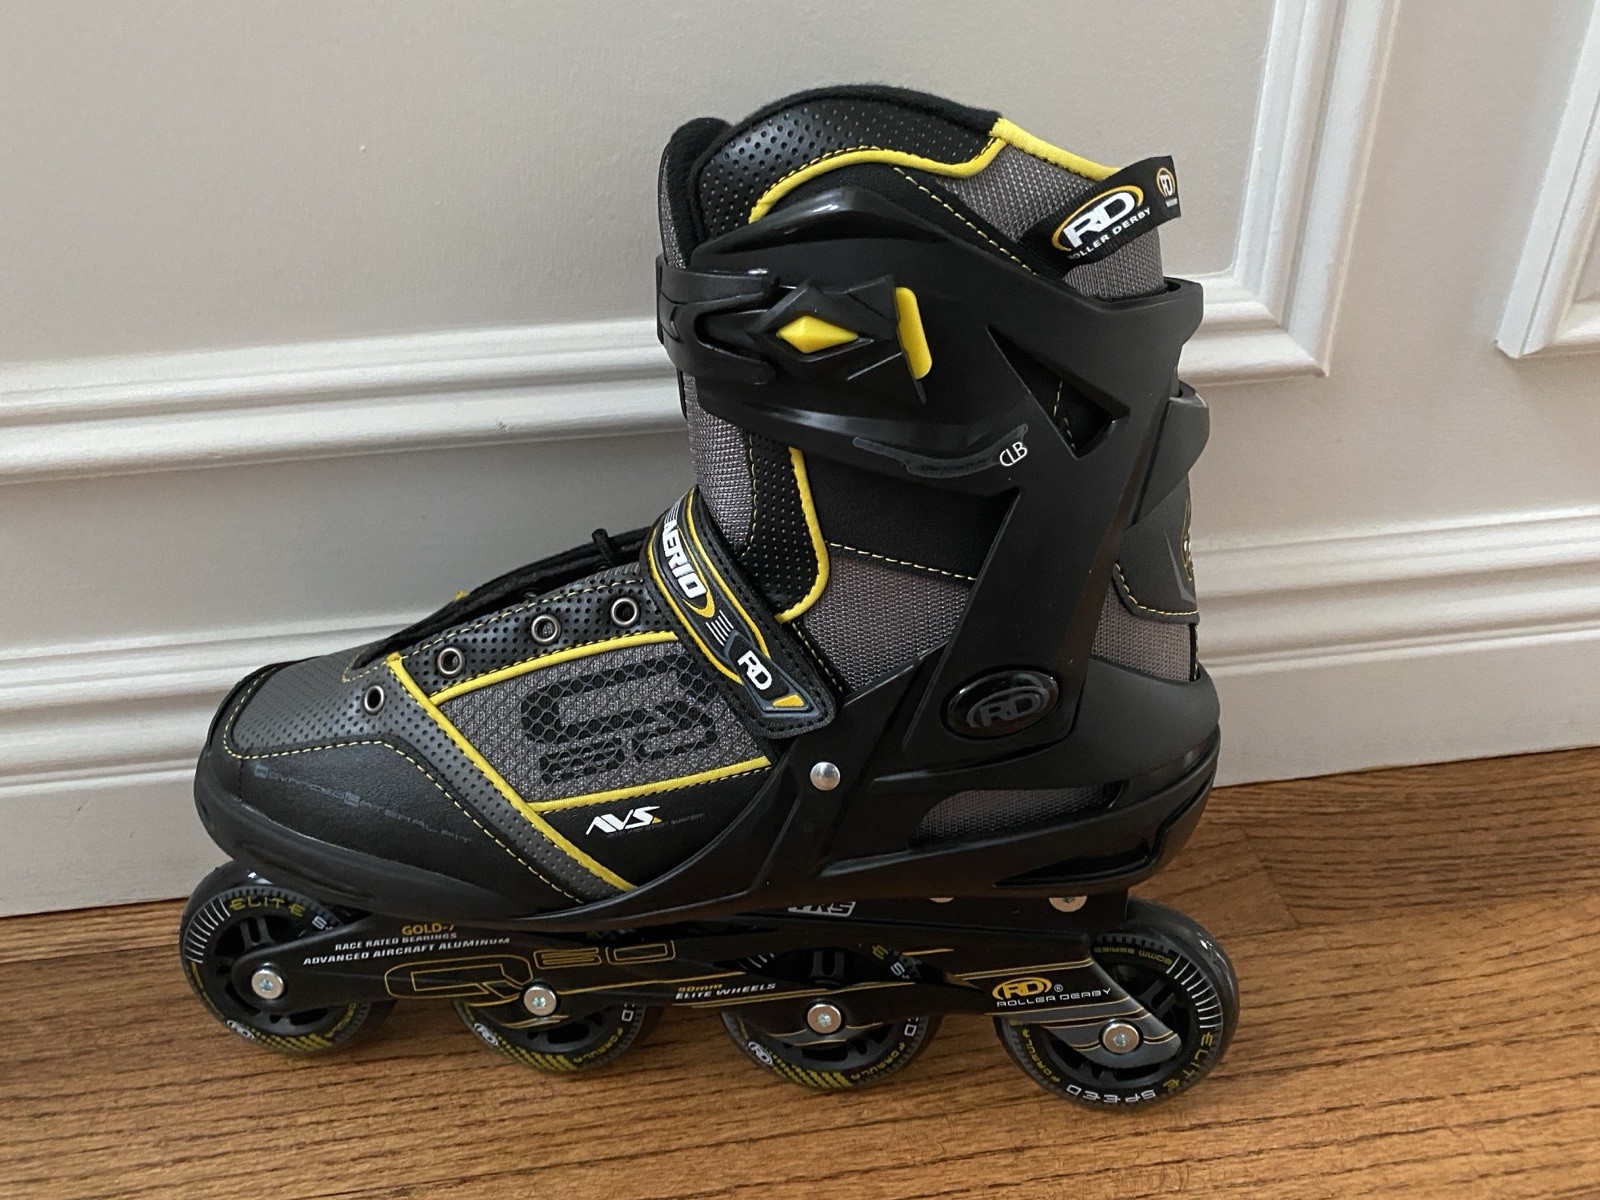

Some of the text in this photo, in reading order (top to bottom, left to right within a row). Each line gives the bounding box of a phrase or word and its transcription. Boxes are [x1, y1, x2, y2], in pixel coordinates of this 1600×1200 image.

[1063, 191, 1136, 248] RD
[1112, 206, 1151, 235] DERBY
[999, 441, 1028, 467] CLB
[662, 519, 708, 599] AERIO
[737, 650, 773, 690] RD
[980, 692, 1041, 728] RD
[229, 896, 306, 918] ELITE
[302, 937, 511, 965] ADVANCED AIRCRAFT ALUMINUM
[334, 932, 458, 951] RACE RATED BEARINGS
[675, 983, 776, 1000] ELITE WHEELS
[997, 987, 1111, 1008] ROLLER DERBY
[1162, 1032, 1213, 1090] ELITE
[1066, 1083, 1156, 1104] SPEED
